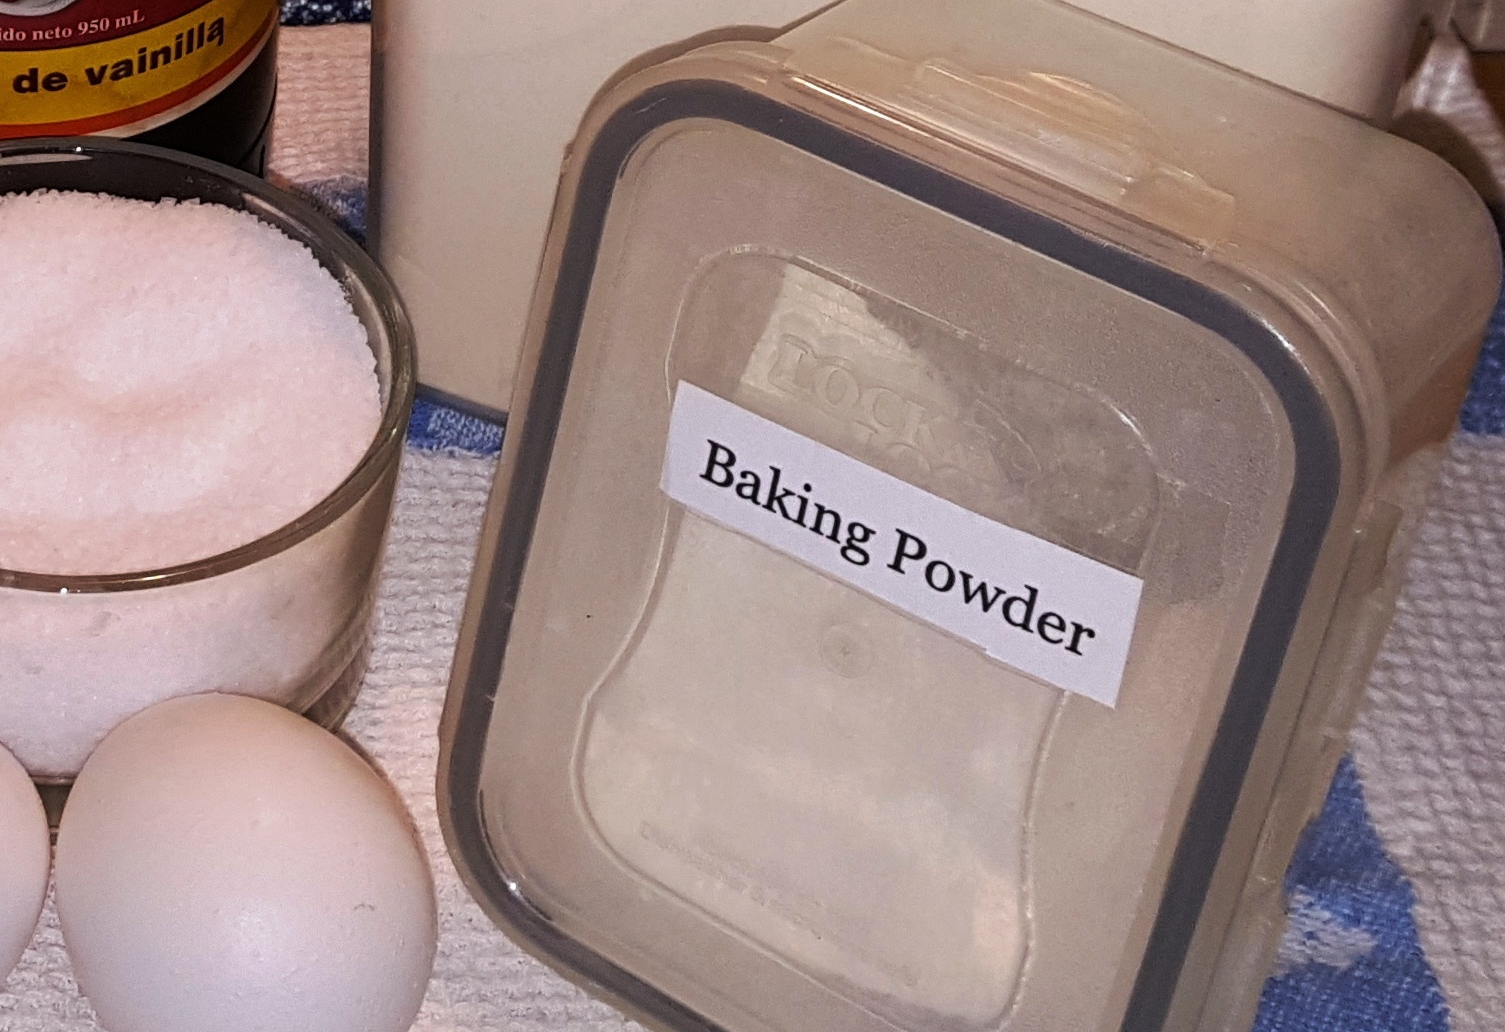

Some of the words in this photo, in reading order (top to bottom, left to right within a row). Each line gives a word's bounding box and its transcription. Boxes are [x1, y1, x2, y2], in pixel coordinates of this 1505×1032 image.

[12, 67, 69, 94] de
[84, 17, 225, 87] vainilla
[32, 25, 73, 41] neto
[77, 17, 110, 37] 950
[115, 9, 145, 29] mL
[699, 439, 876, 567] Baking
[887, 528, 1096, 656] Powder
